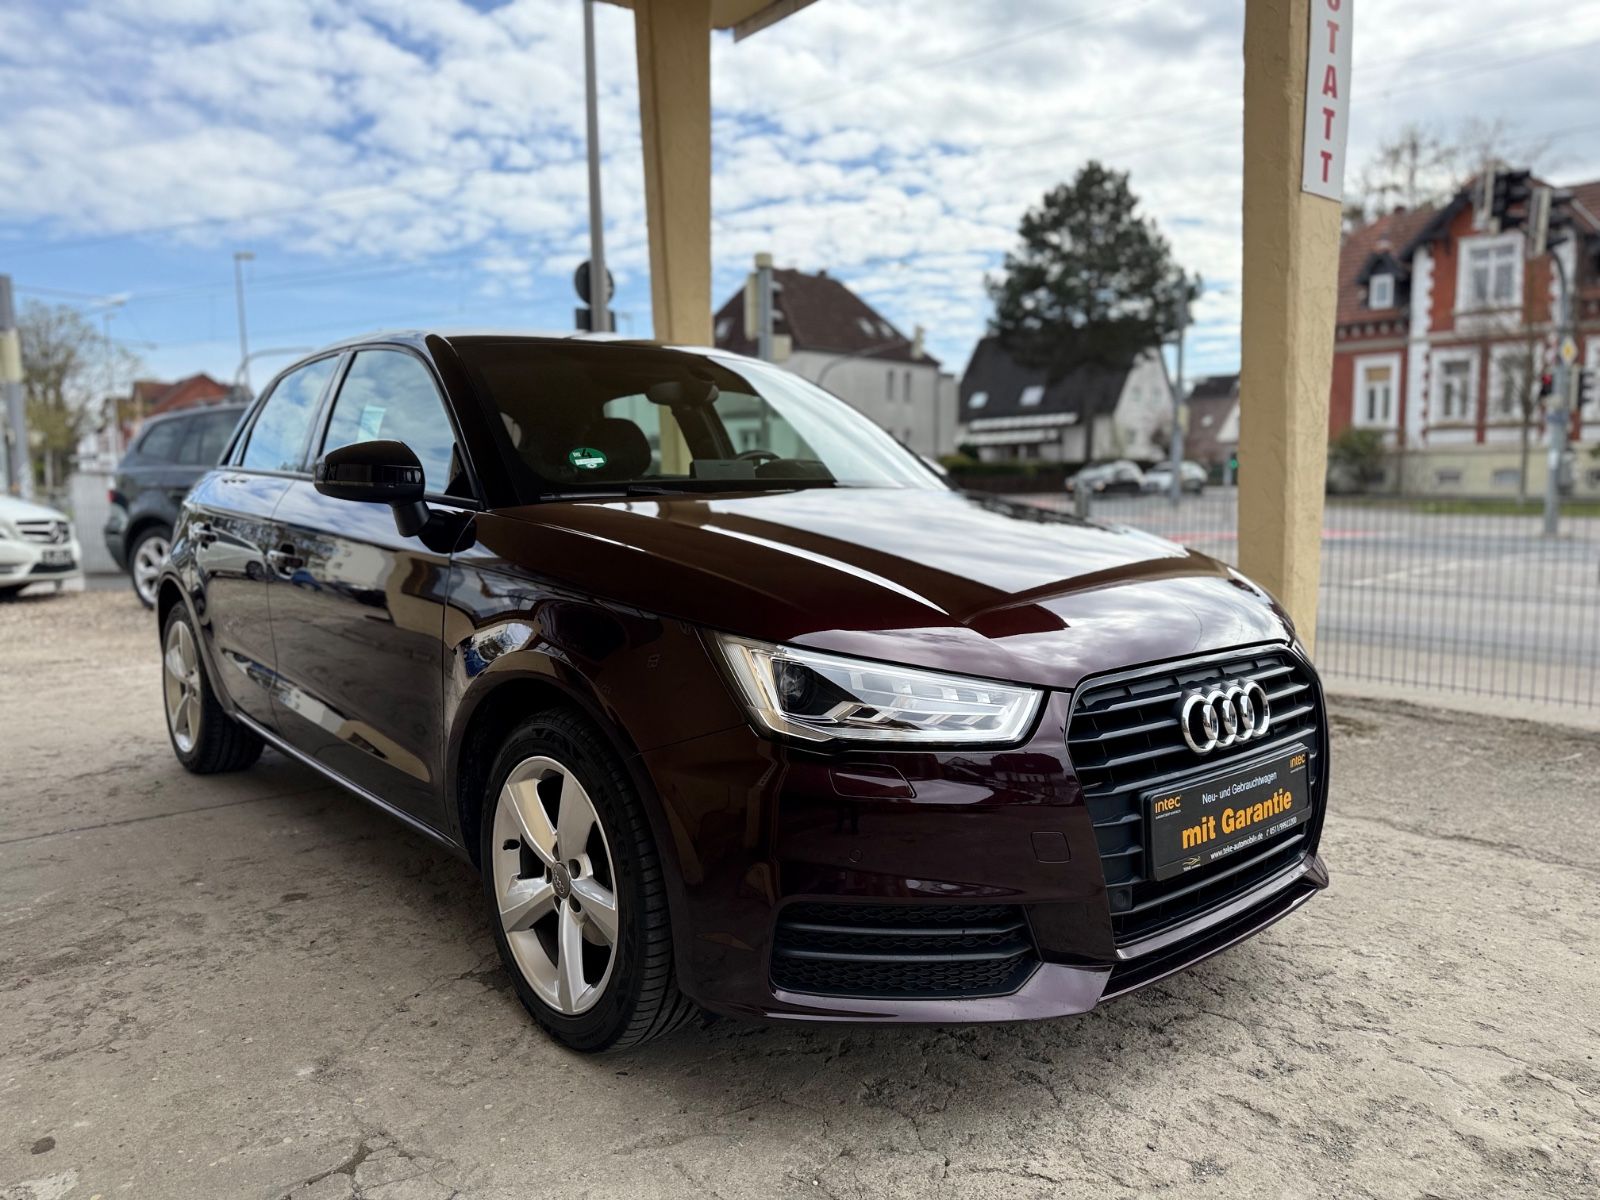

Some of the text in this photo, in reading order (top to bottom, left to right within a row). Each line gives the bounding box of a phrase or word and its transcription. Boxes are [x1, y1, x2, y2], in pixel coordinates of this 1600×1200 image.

[1202, 772, 1278, 804] Neu- und Gebrauchtwagen
[1155, 796, 1181, 813] intec
[1182, 788, 1292, 849] mit Garantie
